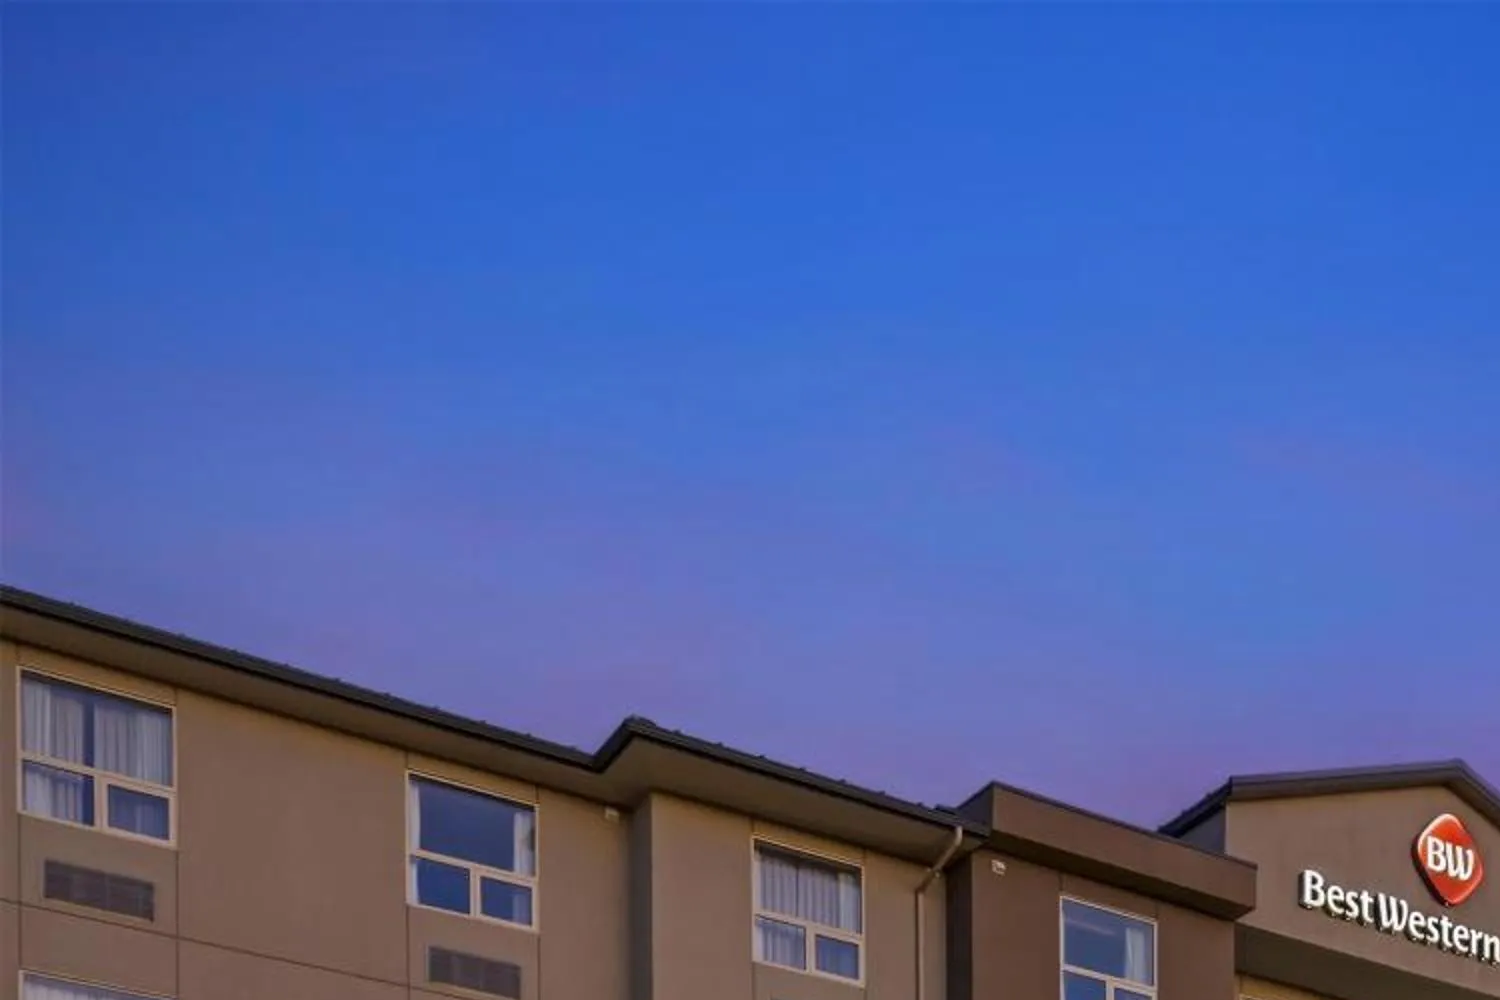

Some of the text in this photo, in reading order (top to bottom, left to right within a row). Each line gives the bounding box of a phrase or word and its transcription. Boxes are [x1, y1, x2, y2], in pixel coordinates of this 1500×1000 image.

[1426, 835, 1475, 881] BW
[1303, 869, 1374, 923] Best
[1377, 894, 1500, 963] Western
